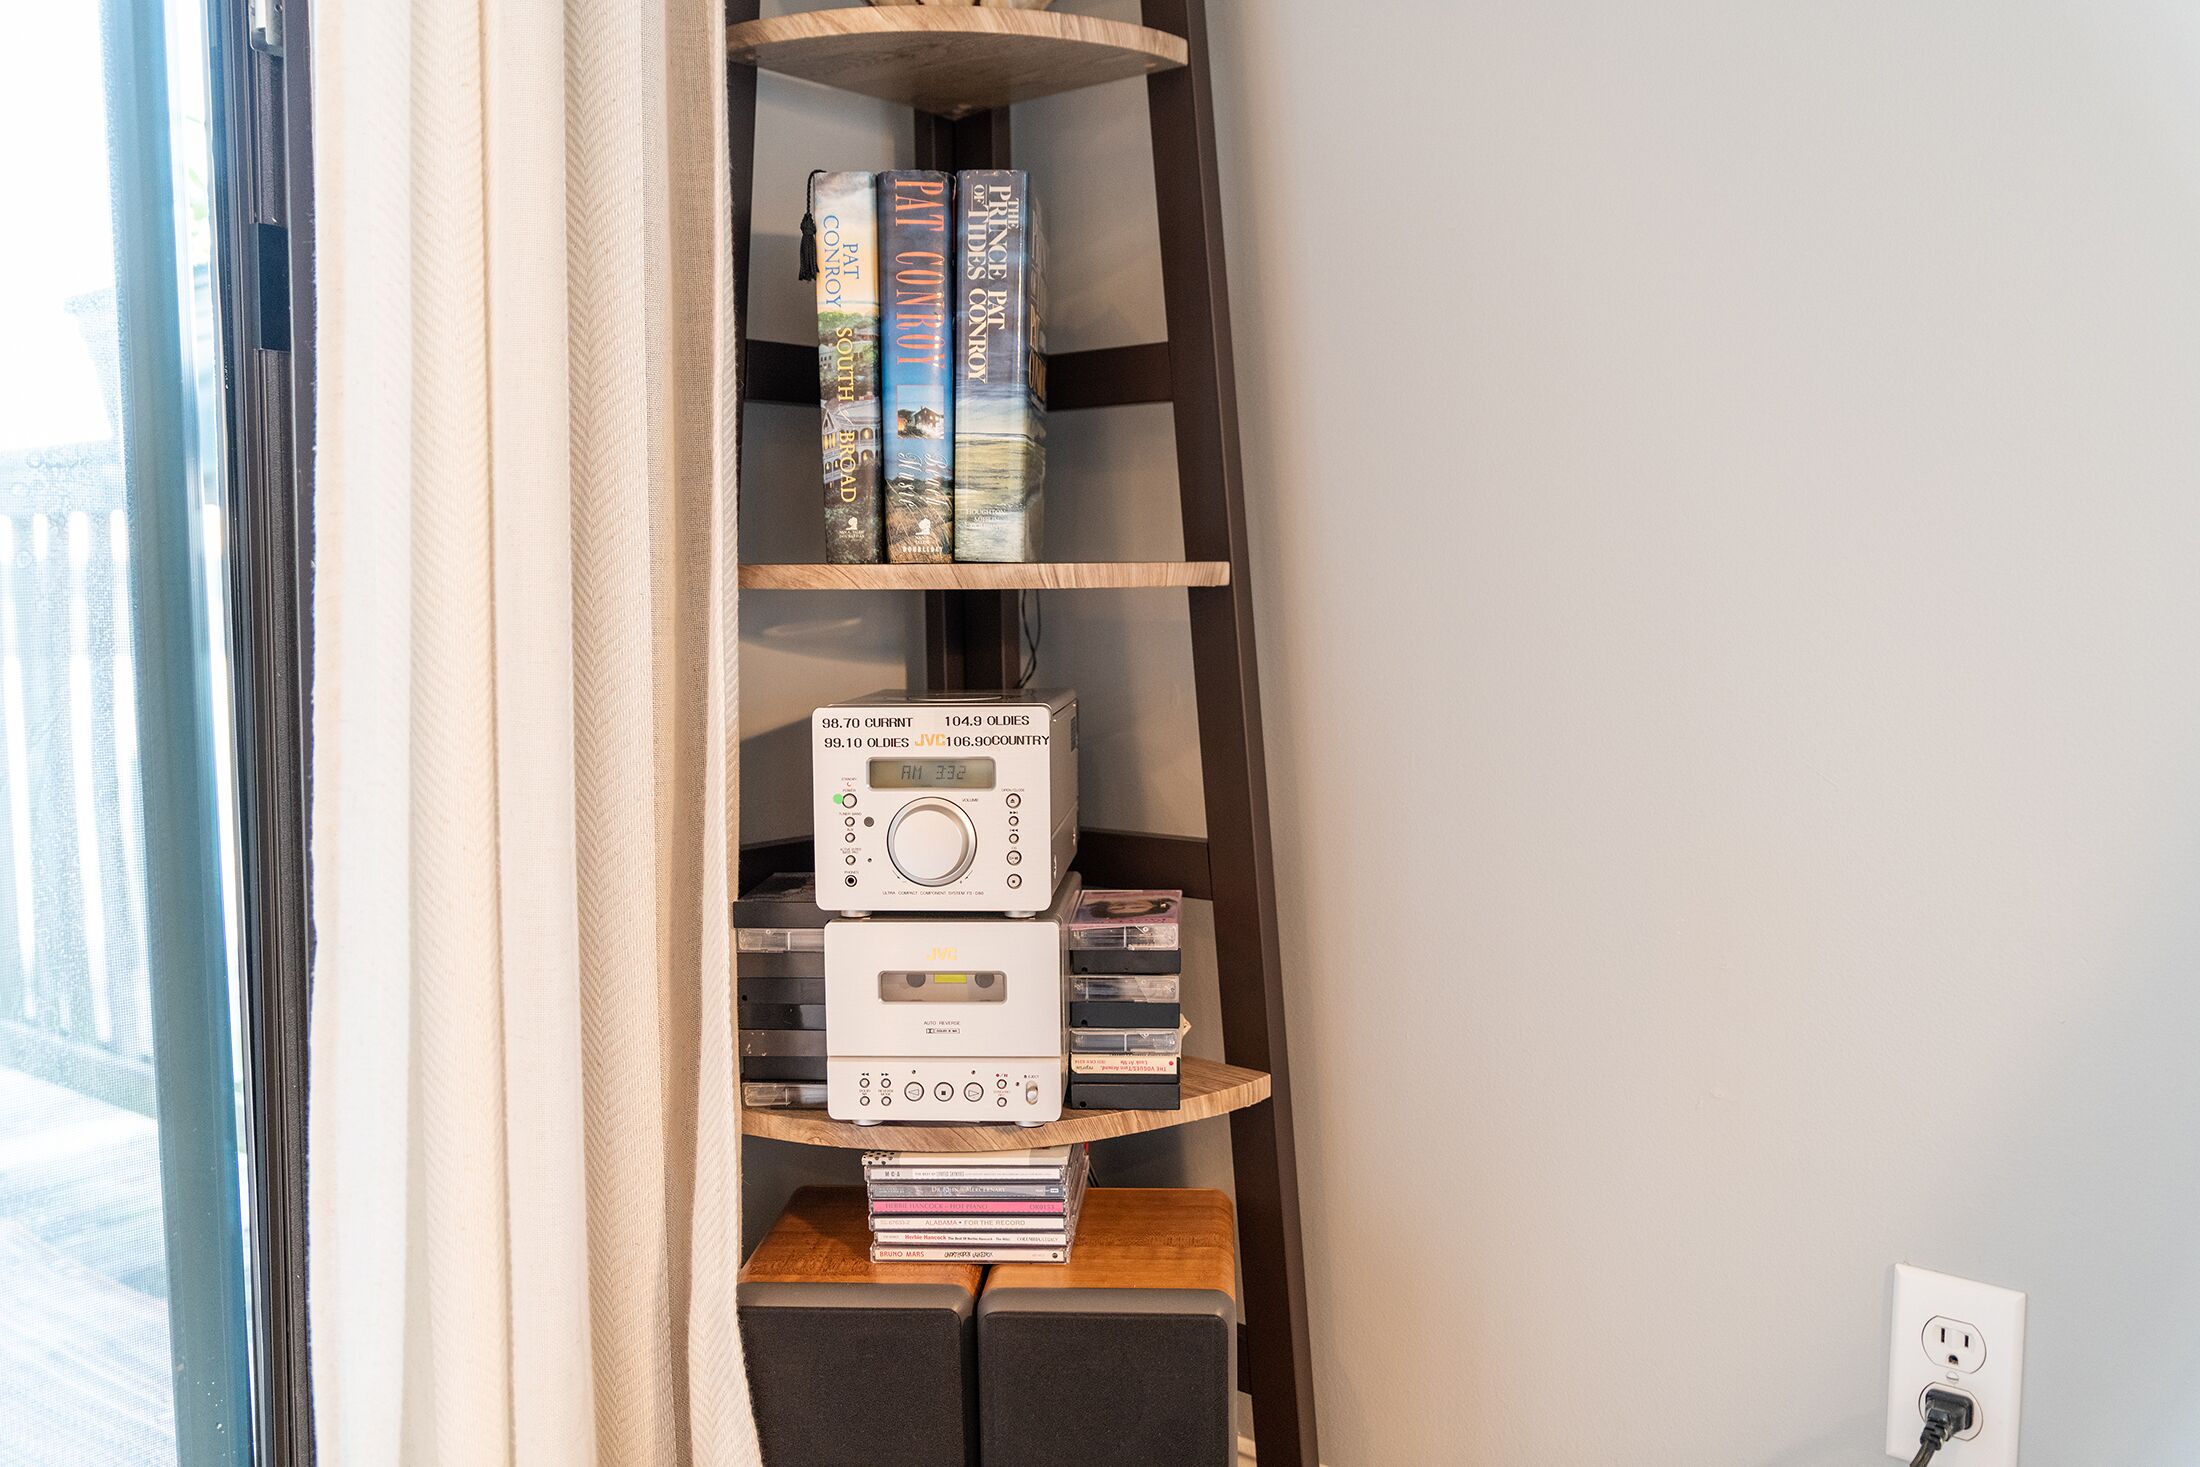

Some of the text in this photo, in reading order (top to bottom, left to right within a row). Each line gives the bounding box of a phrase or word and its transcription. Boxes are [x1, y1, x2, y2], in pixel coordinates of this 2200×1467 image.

[967, 184, 989, 280] OF TIDES
[988, 185, 1012, 280] PRINCE
[1007, 198, 1020, 230] THE
[823, 215, 842, 308] CONROY
[842, 243, 860, 279] PAT
[894, 179, 945, 369] PAT CONROY
[987, 289, 1008, 331] PAT
[968, 288, 987, 384] CONROY
[836, 327, 855, 402] SOUTH
[839, 430, 857, 504] BROAD
[822, 717, 914, 729] 98.70 CURRNT
[914, 733, 947, 747] JVC
[945, 715, 1030, 727] 104.9 OLDIES
[824, 737, 910, 748] 99.10 OLDIES
[901, 765, 922, 780] AM
[927, 947, 958, 961] JVC
